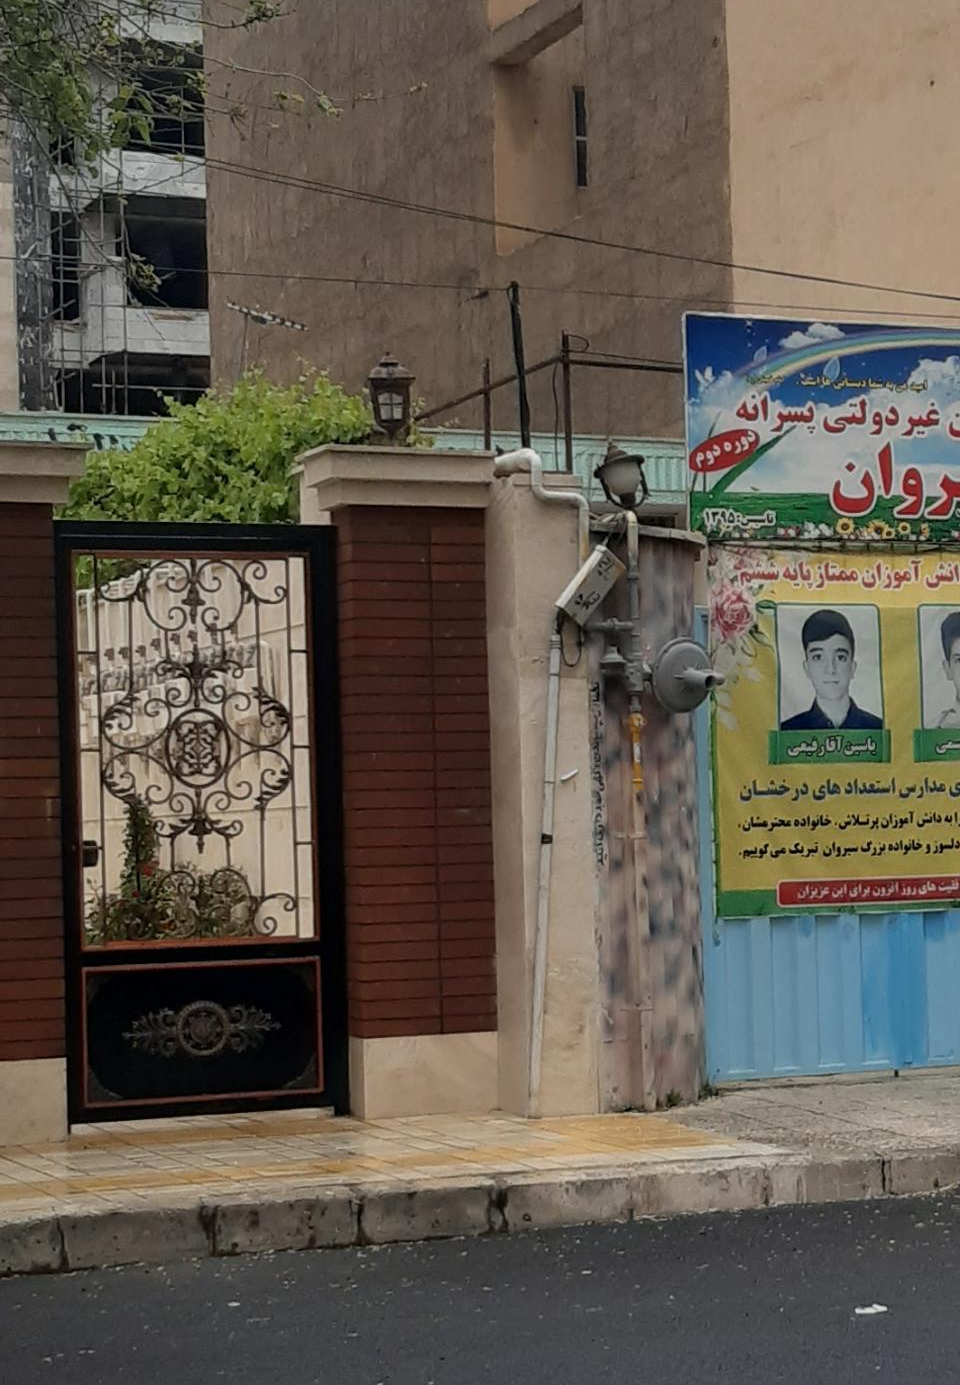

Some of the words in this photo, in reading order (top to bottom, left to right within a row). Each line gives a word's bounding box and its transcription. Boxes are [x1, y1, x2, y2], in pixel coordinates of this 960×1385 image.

[868, 377, 884, 389] شما
[735, 392, 817, 433] پسرانه
[724, 431, 757, 455] دوره
[694, 445, 722, 466] دوم
[738, 562, 780, 588] ششم
[783, 562, 814, 590] پایه
[815, 563, 859, 589] ممتاز
[860, 559, 922, 589] آموزان
[842, 736, 877, 758] یاسین
[811, 777, 841, 799] های
[844, 776, 896, 798] استعداد
[899, 778, 947, 803] مدارس
[793, 813, 832, 832] خانواده
[880, 810, 915, 829] آموزان
[916, 811, 943, 828] دانش
[944, 813, 953, 827] به
[770, 847, 787, 859] می
[788, 841, 820, 859] تبریک
[822, 839, 859, 858] سیروان
[860, 839, 886, 857] بزرگ
[888, 837, 923, 855] خانواده
[924, 843, 931, 855] و
[933, 837, 960, 855] دلسوز
[796, 883, 830, 900] عزیزان
[831, 883, 847, 899] این
[848, 882, 871, 898] برای
[900, 883, 918, 897] روز
[917, 880, 937, 896] های
